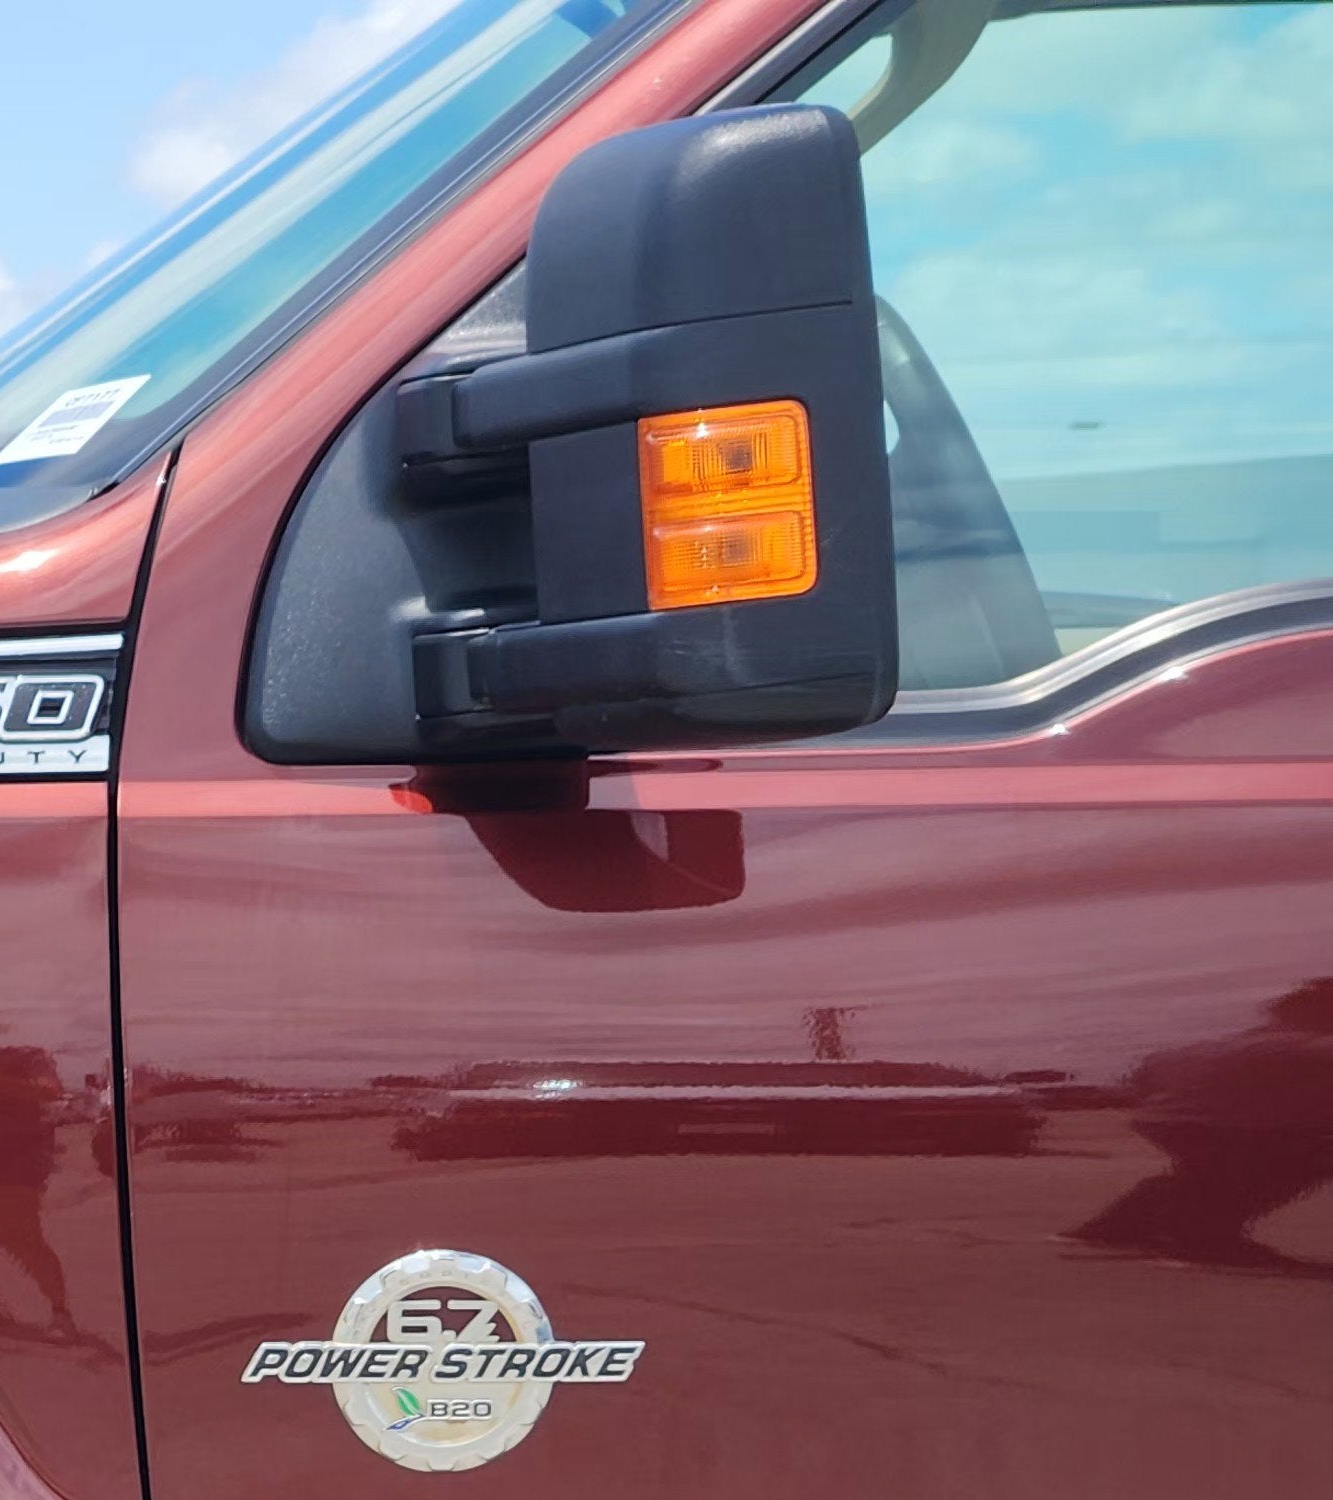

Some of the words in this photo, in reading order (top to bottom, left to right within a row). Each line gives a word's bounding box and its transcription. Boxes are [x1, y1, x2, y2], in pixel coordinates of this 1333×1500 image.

[386, 1299, 501, 1342] 6.7
[242, 1342, 432, 1382] POWER
[432, 1342, 644, 1382] STROKE
[428, 1400, 493, 1419] B20
